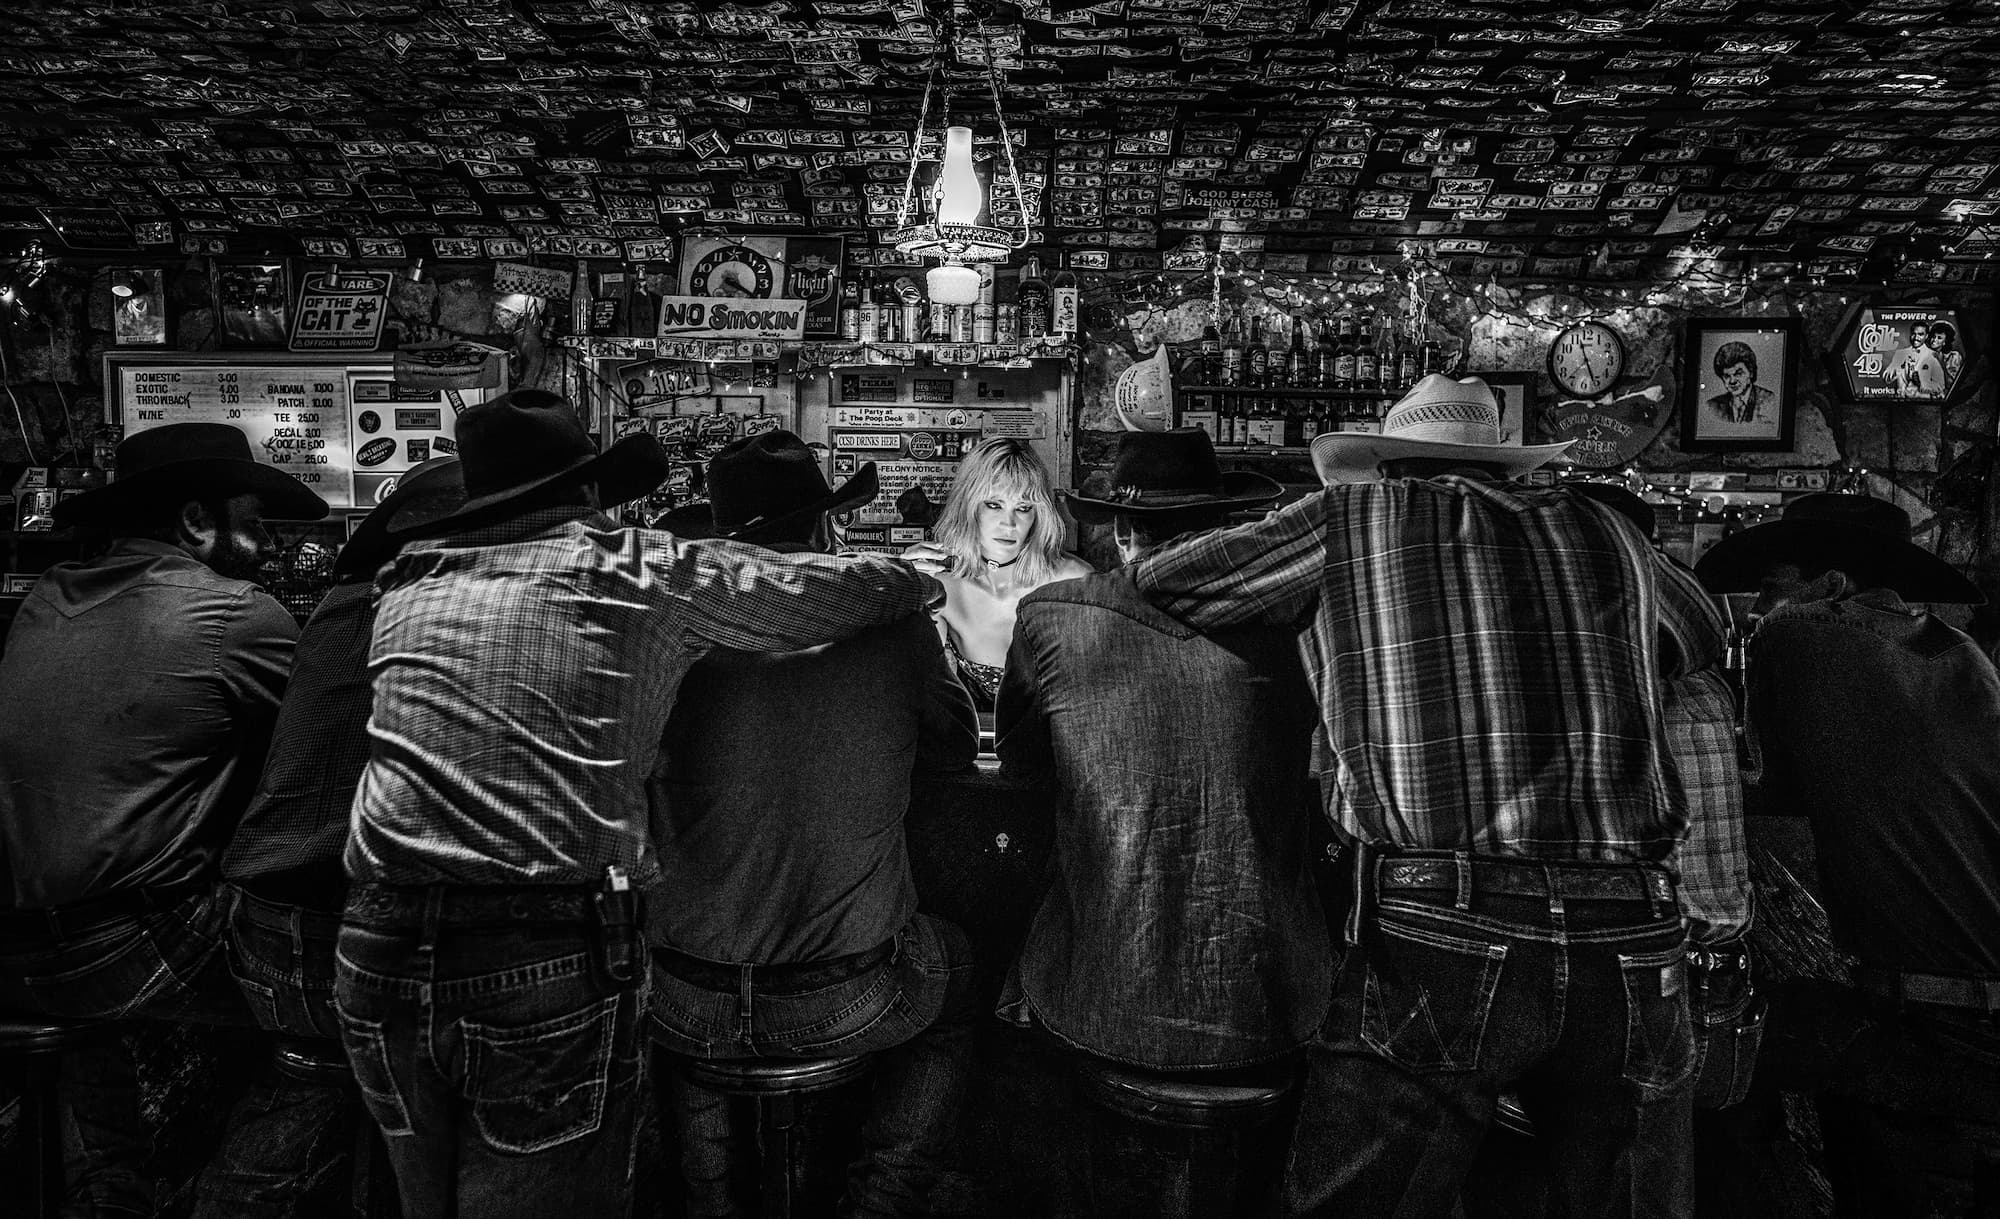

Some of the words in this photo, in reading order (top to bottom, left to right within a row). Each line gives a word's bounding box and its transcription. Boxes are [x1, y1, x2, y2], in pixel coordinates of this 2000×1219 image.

[1199, 189, 1228, 199] GOD
[1231, 190, 1273, 199] BLESS
[1187, 198, 1240, 208] JOHNNY
[1243, 198, 1280, 209] CASH
[305, 297, 323, 308] OF
[326, 297, 353, 308] THE
[663, 303, 705, 326] NO
[1894, 312, 1927, 321] POWER
[301, 309, 351, 331] CAT
[1853, 353, 1883, 375] 45
[135, 373, 181, 382] DOMESTIC
[136, 384, 169, 394] EXOTIC
[267, 385, 306, 395] BANDANA
[1864, 386, 1870, 394] It
[1871, 386, 1896, 395] works
[136, 391, 191, 408] THROWBACK
[278, 398, 305, 408] PATCH
[138, 410, 164, 420] WINE
[864, 408, 884, 416] Party
[273, 413, 291, 422] TEE
[865, 415, 883, 423] Poop
[274, 428, 303, 438] DECAL
[846, 530, 884, 542] VANDOLIERS
